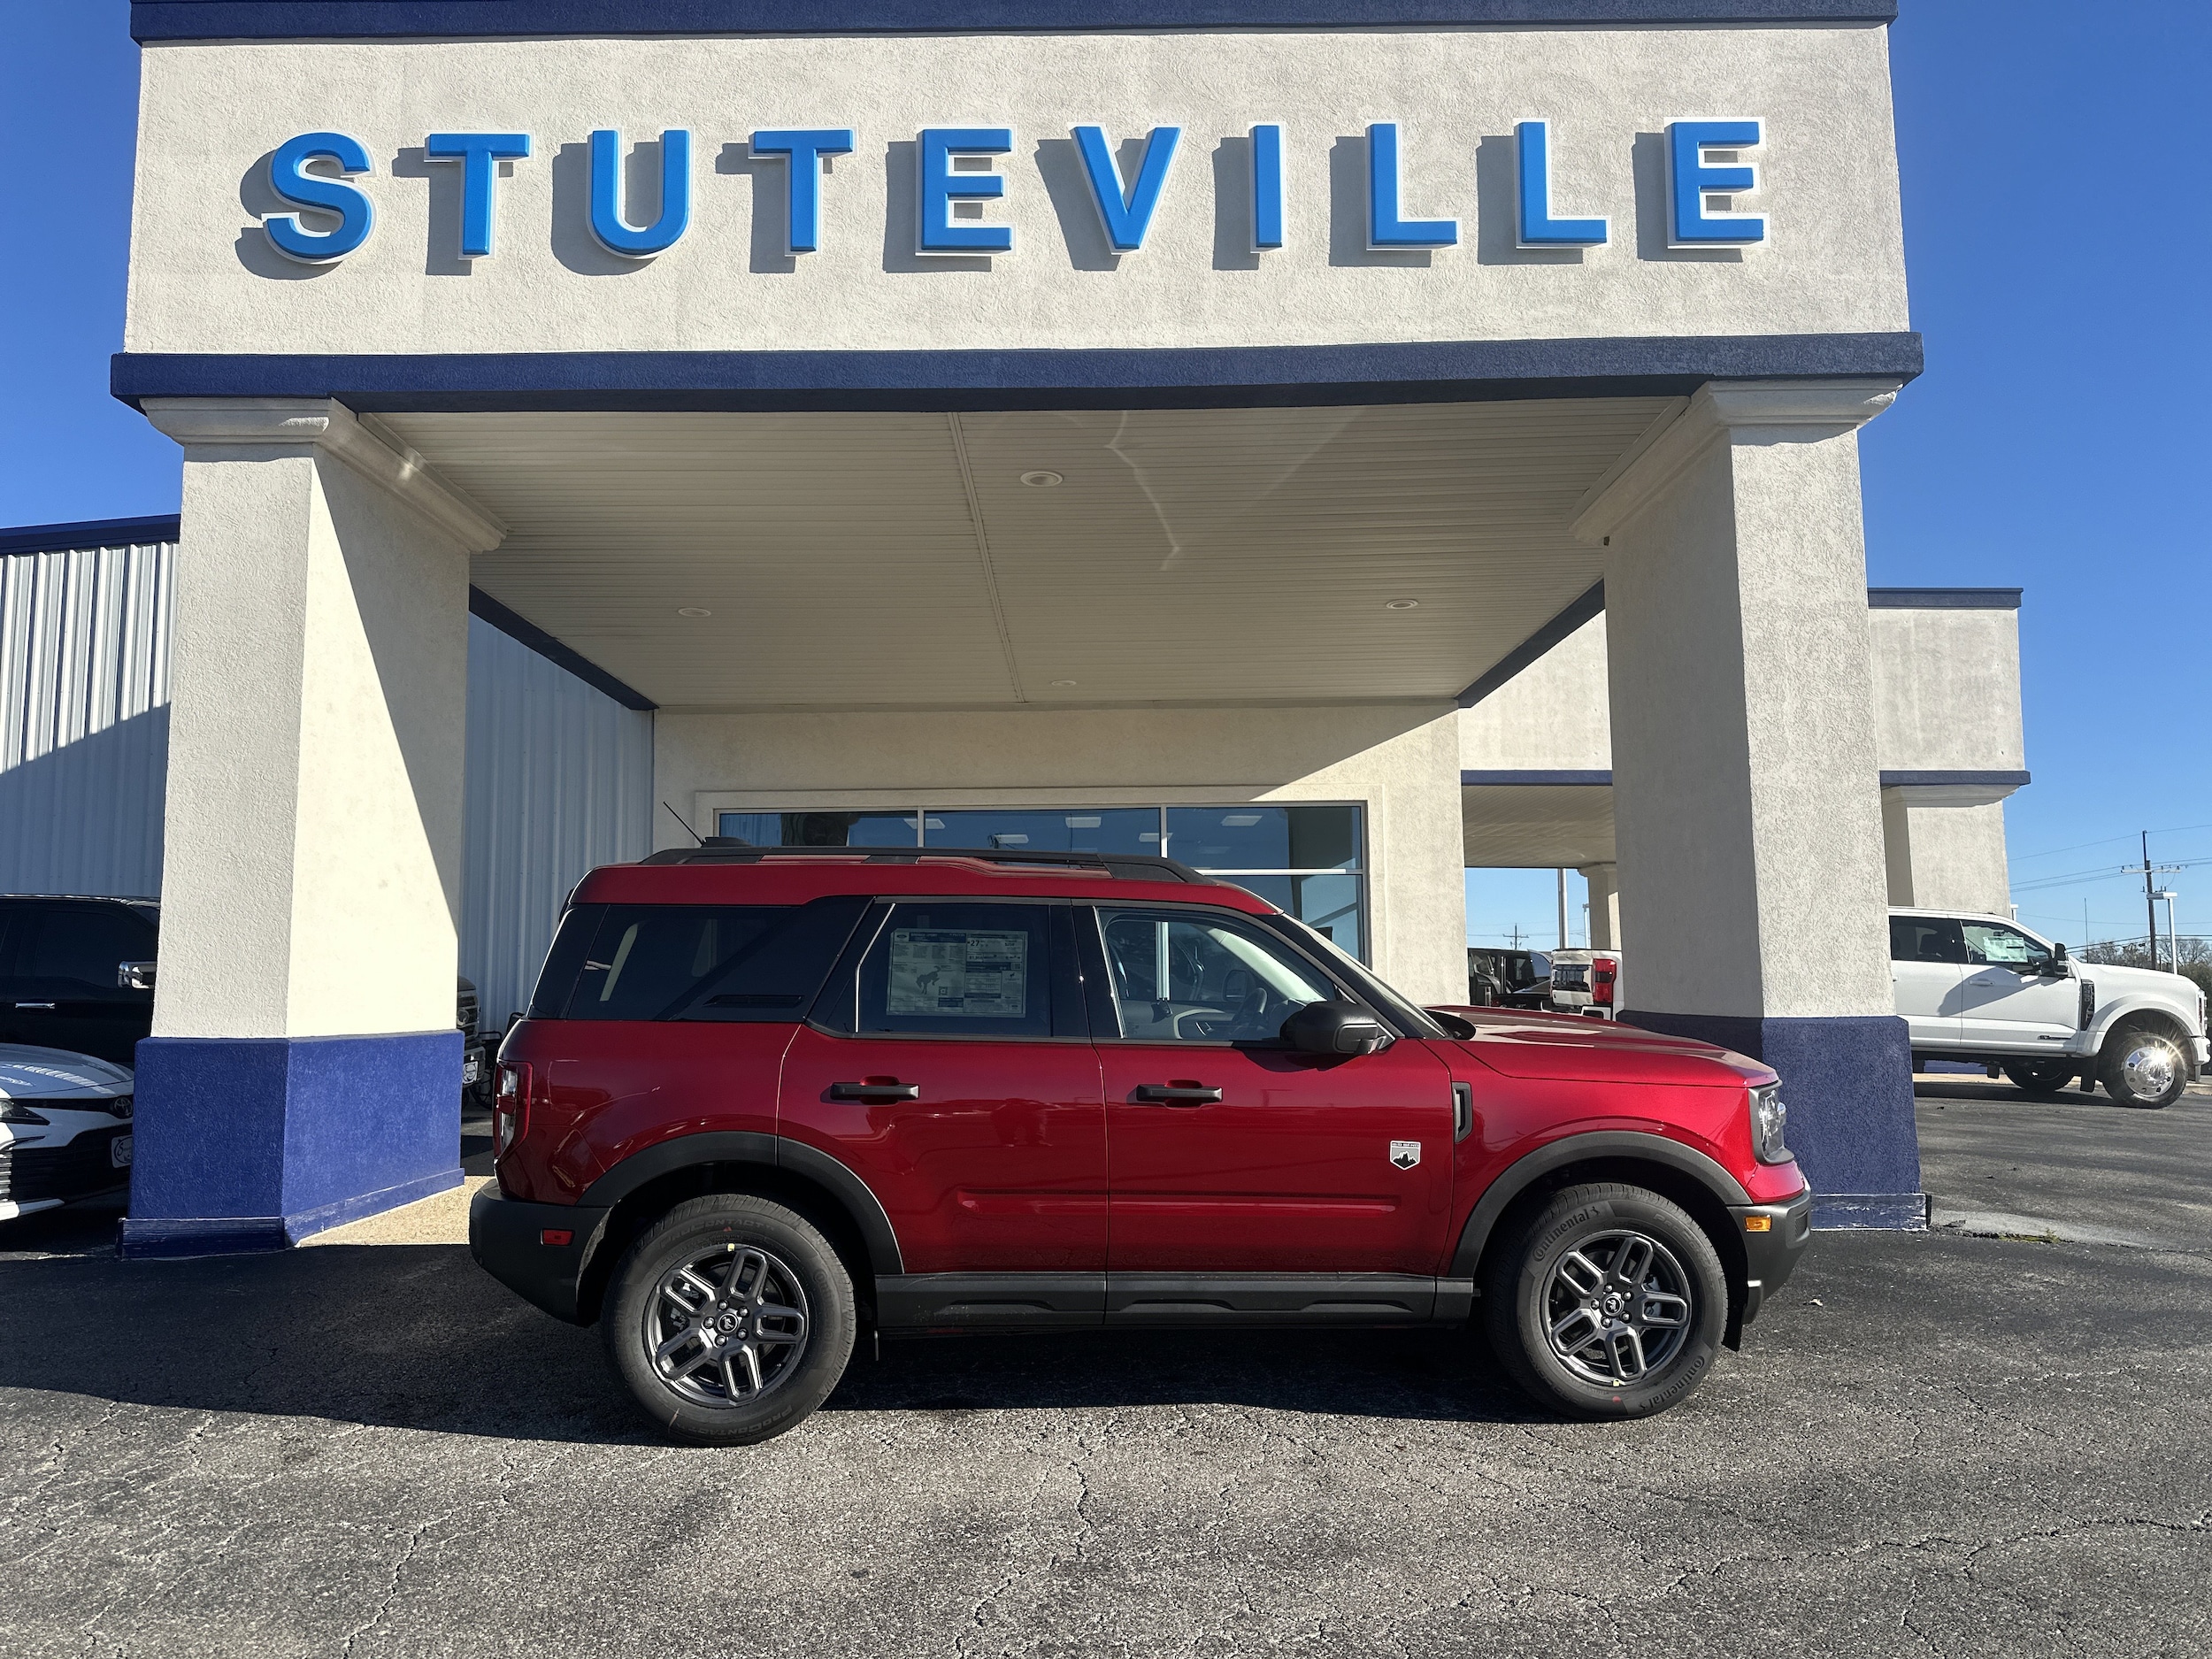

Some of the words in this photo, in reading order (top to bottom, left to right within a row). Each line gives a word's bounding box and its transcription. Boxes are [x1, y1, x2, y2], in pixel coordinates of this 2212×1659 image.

[262, 118, 1768, 263] STUTEVILLE
[1533, 1209, 1589, 1262] Continental
[1649, 1356, 1705, 1408] Continental
